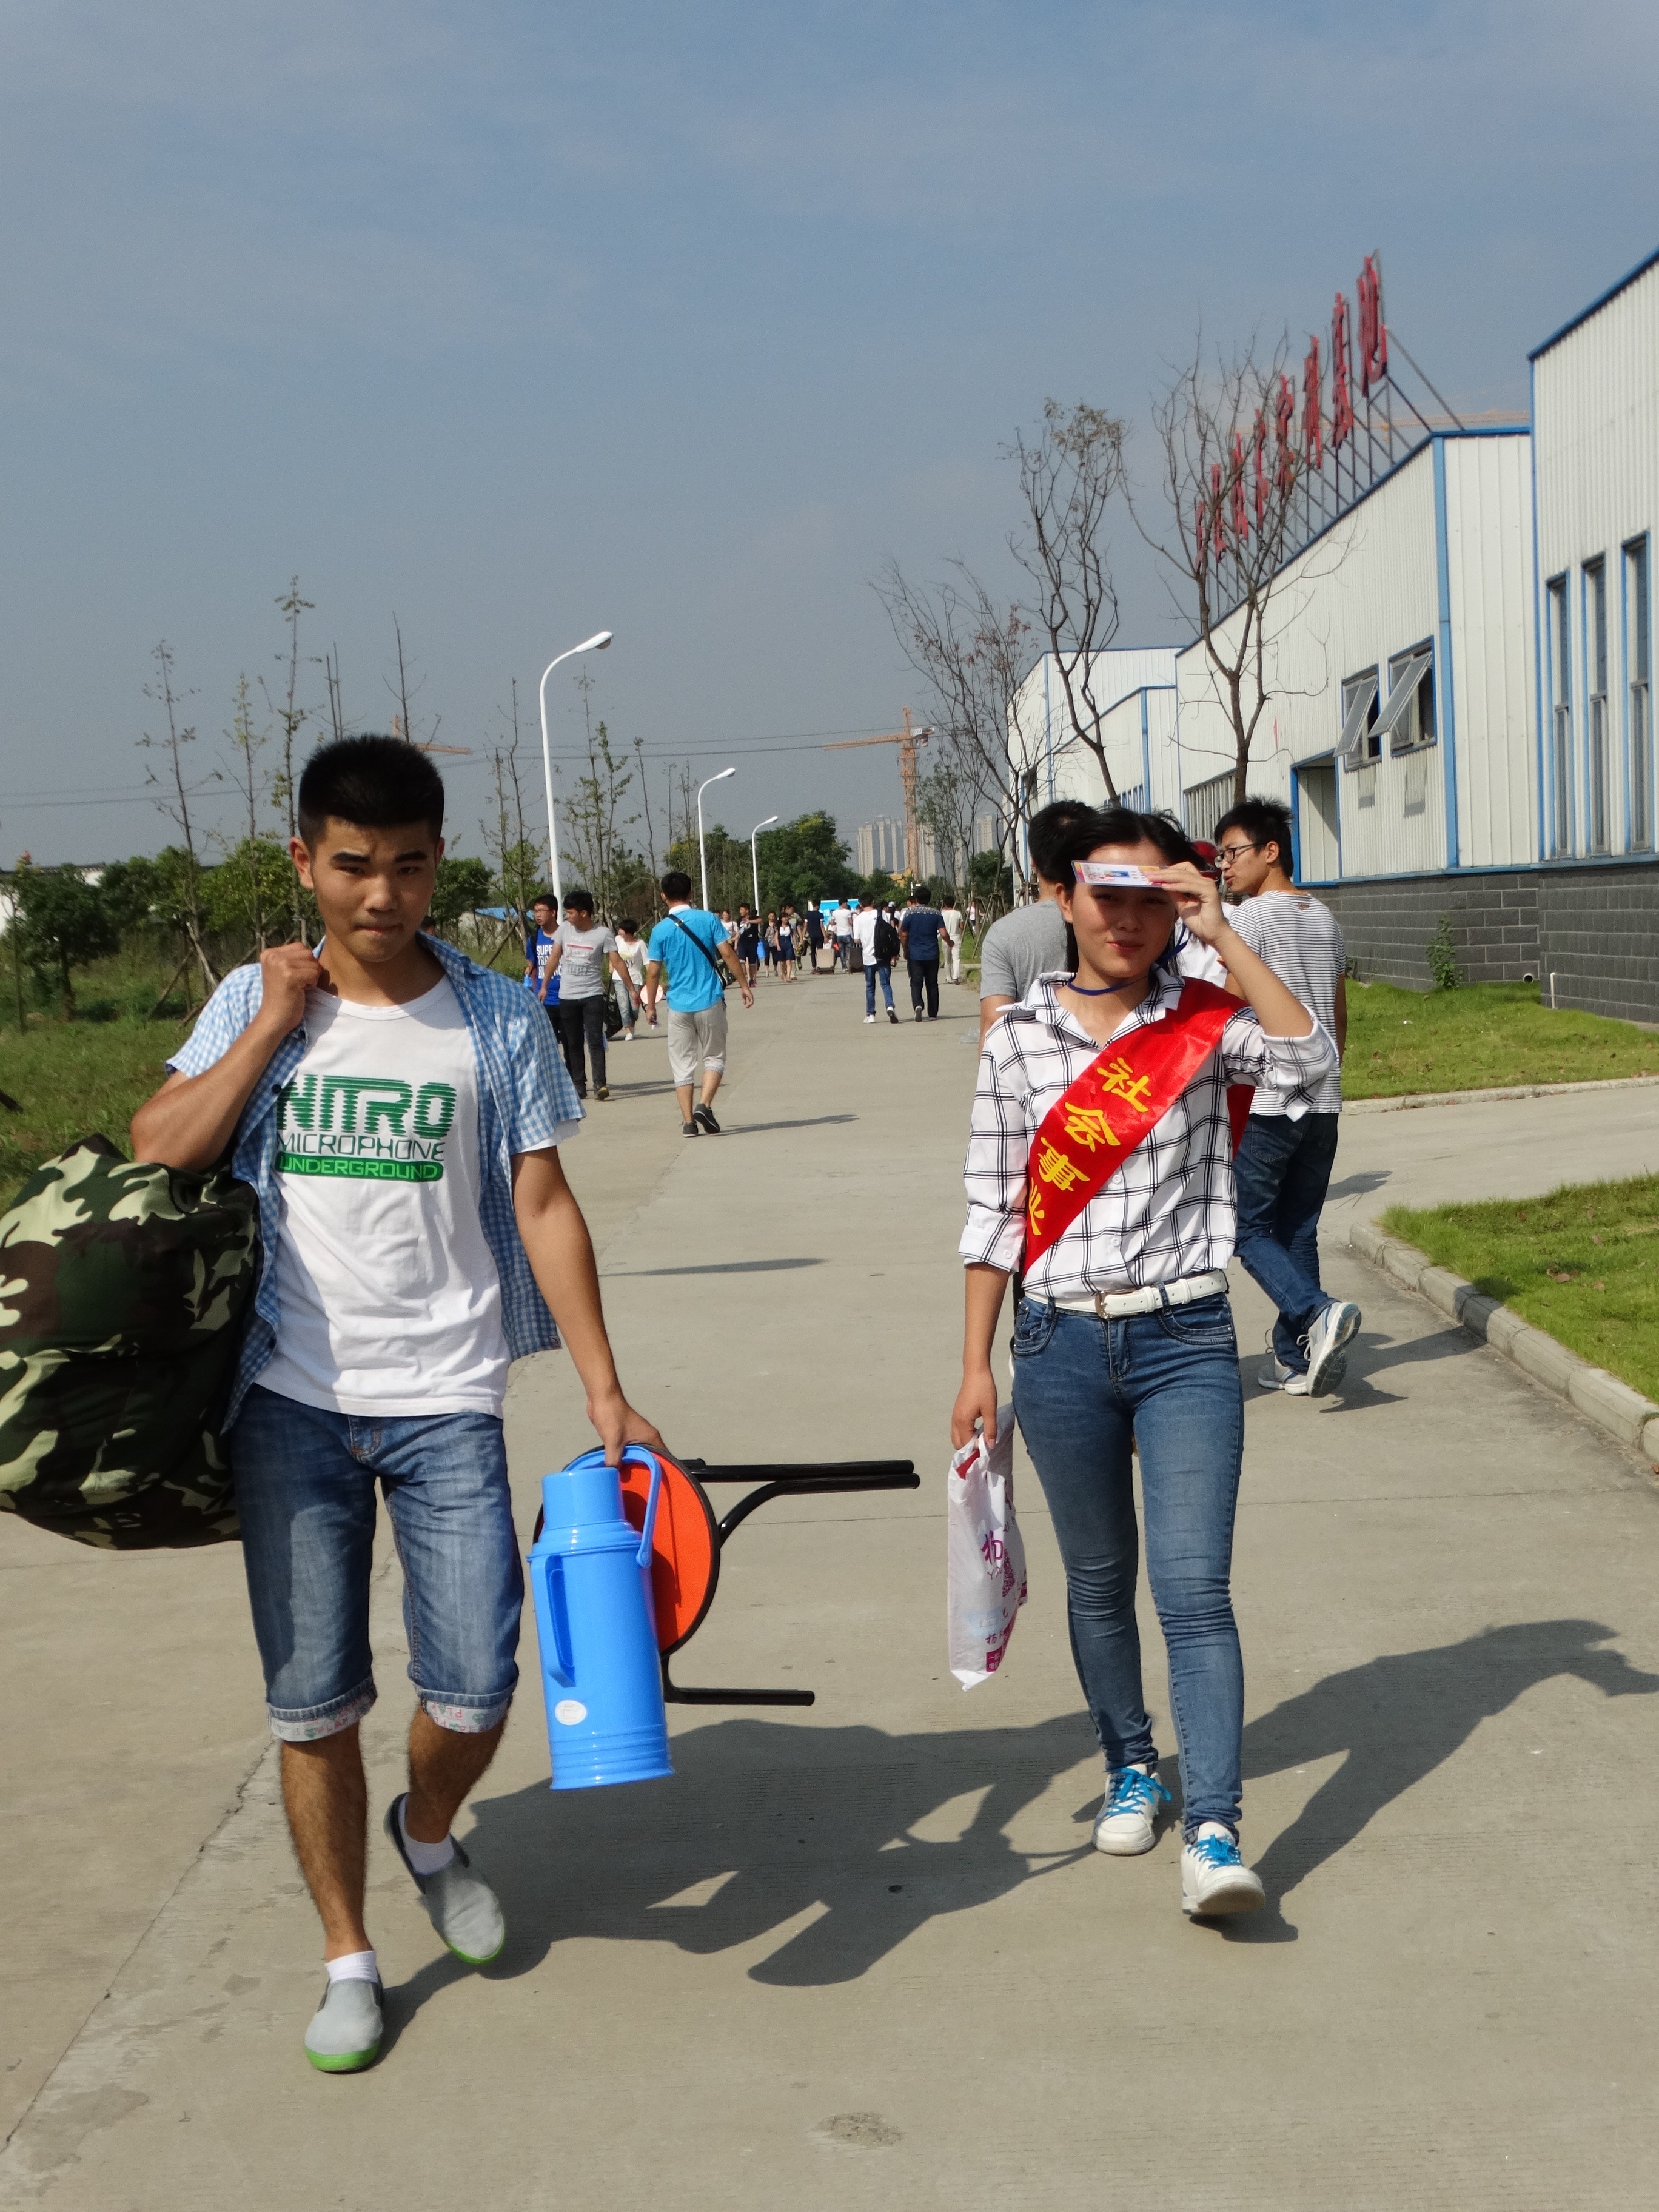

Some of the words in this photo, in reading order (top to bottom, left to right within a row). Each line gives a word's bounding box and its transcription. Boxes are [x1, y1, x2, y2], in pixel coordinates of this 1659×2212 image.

[276, 1074, 457, 1140] NITRO
[277, 1133, 446, 1162] MICROPHONE
[280, 1156, 438, 1179] UNDERGROUND
